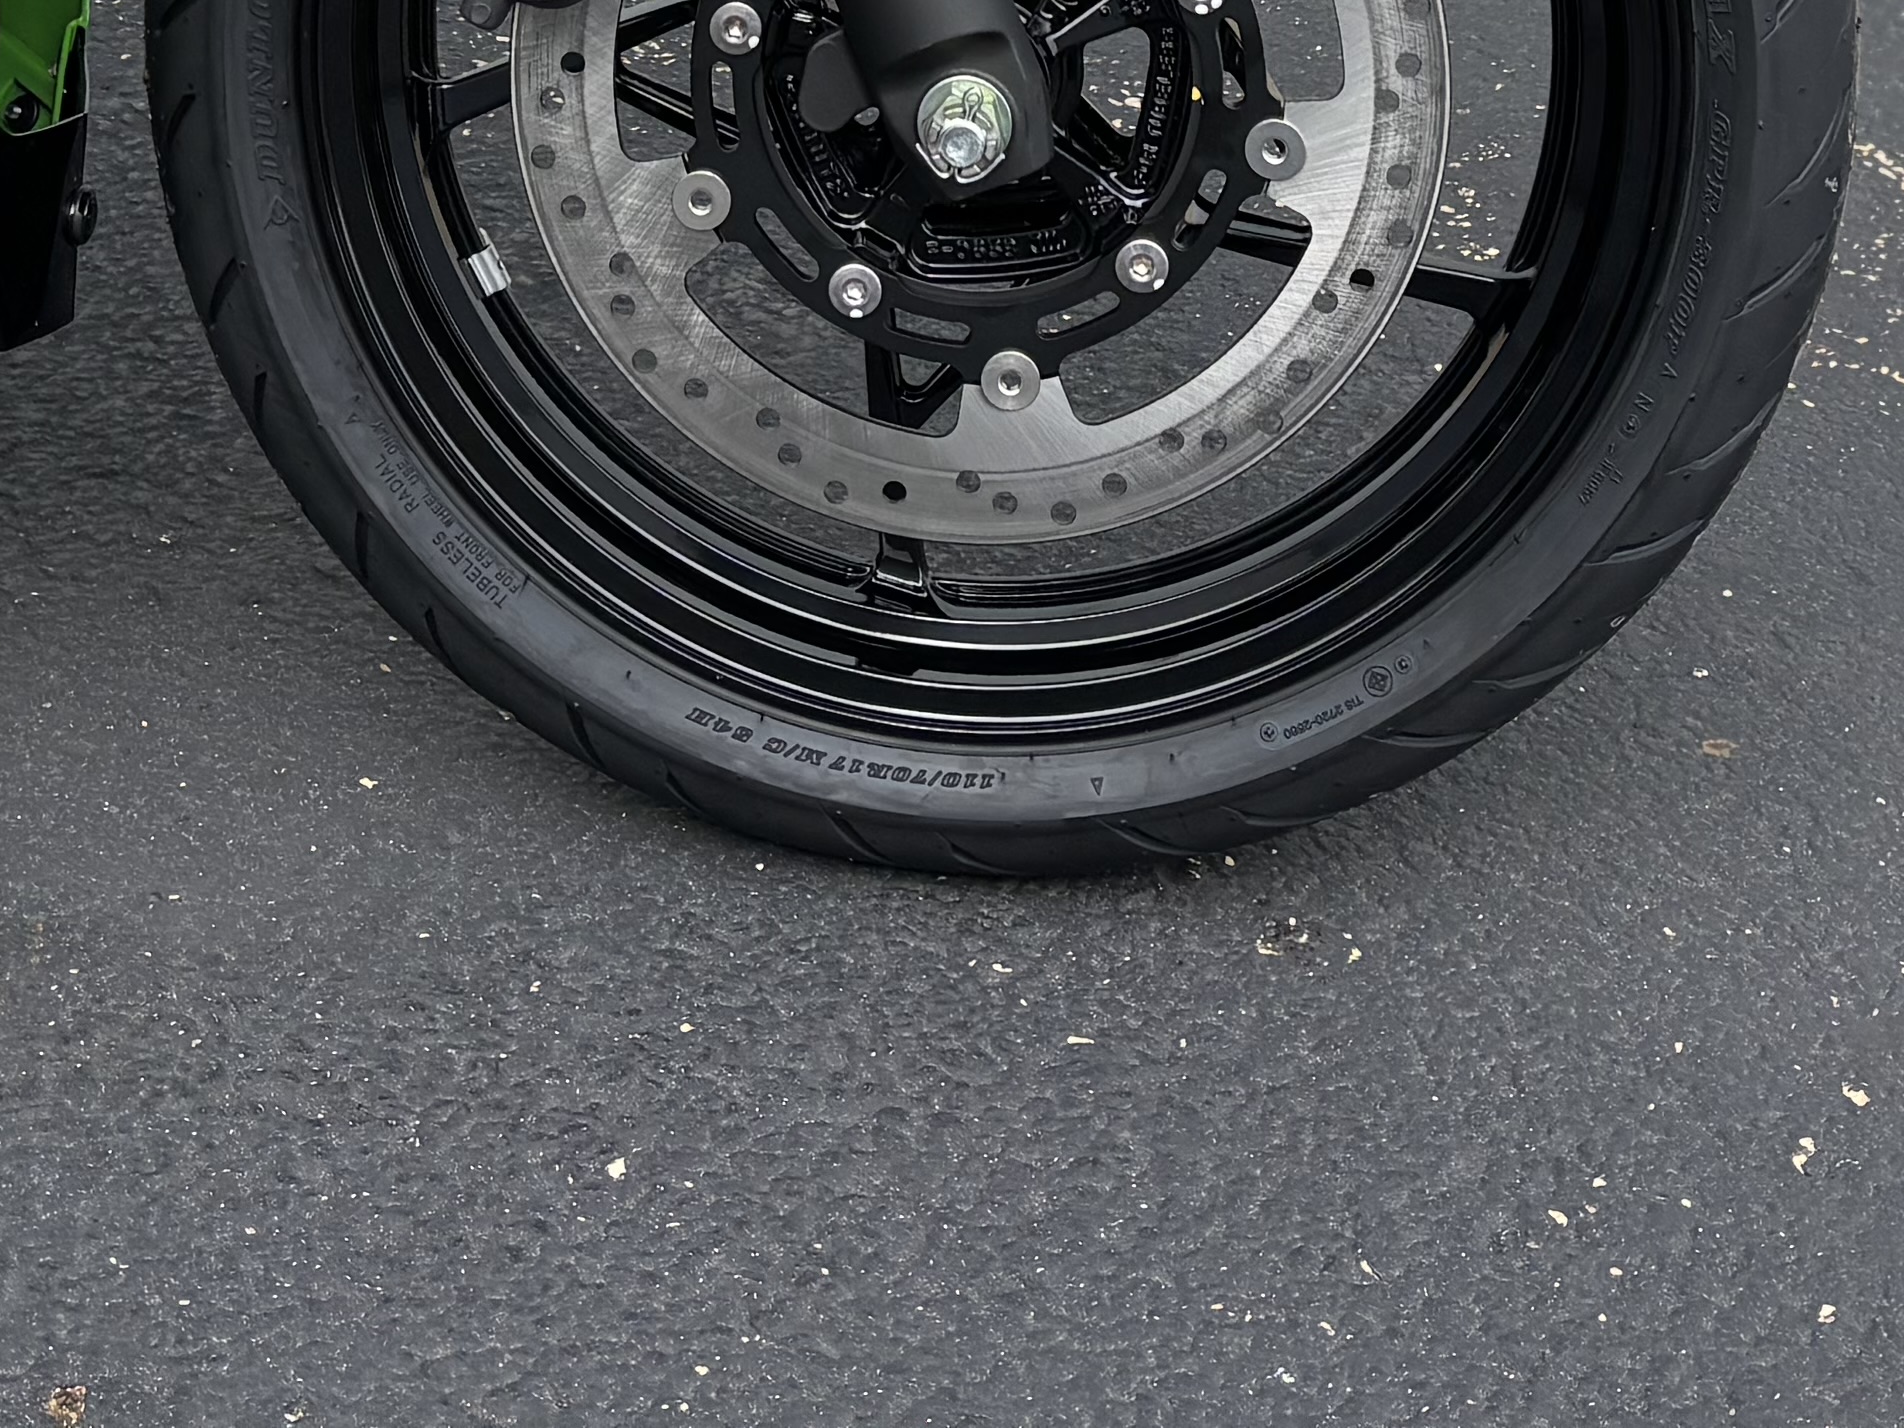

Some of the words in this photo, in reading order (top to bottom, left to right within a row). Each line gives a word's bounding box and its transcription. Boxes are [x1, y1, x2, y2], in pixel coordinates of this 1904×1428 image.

[374, 453, 420, 514] RADIAL
[395, 459, 420, 486] USE
[420, 491, 456, 528] WHEEL
[453, 531, 495, 569] FRONT
[432, 530, 509, 610] TUBELESS
[494, 568, 523, 594] FOR
[684, 706, 754, 743] 54H
[762, 736, 828, 767] M/C
[828, 755, 995, 790] 110/70R17
